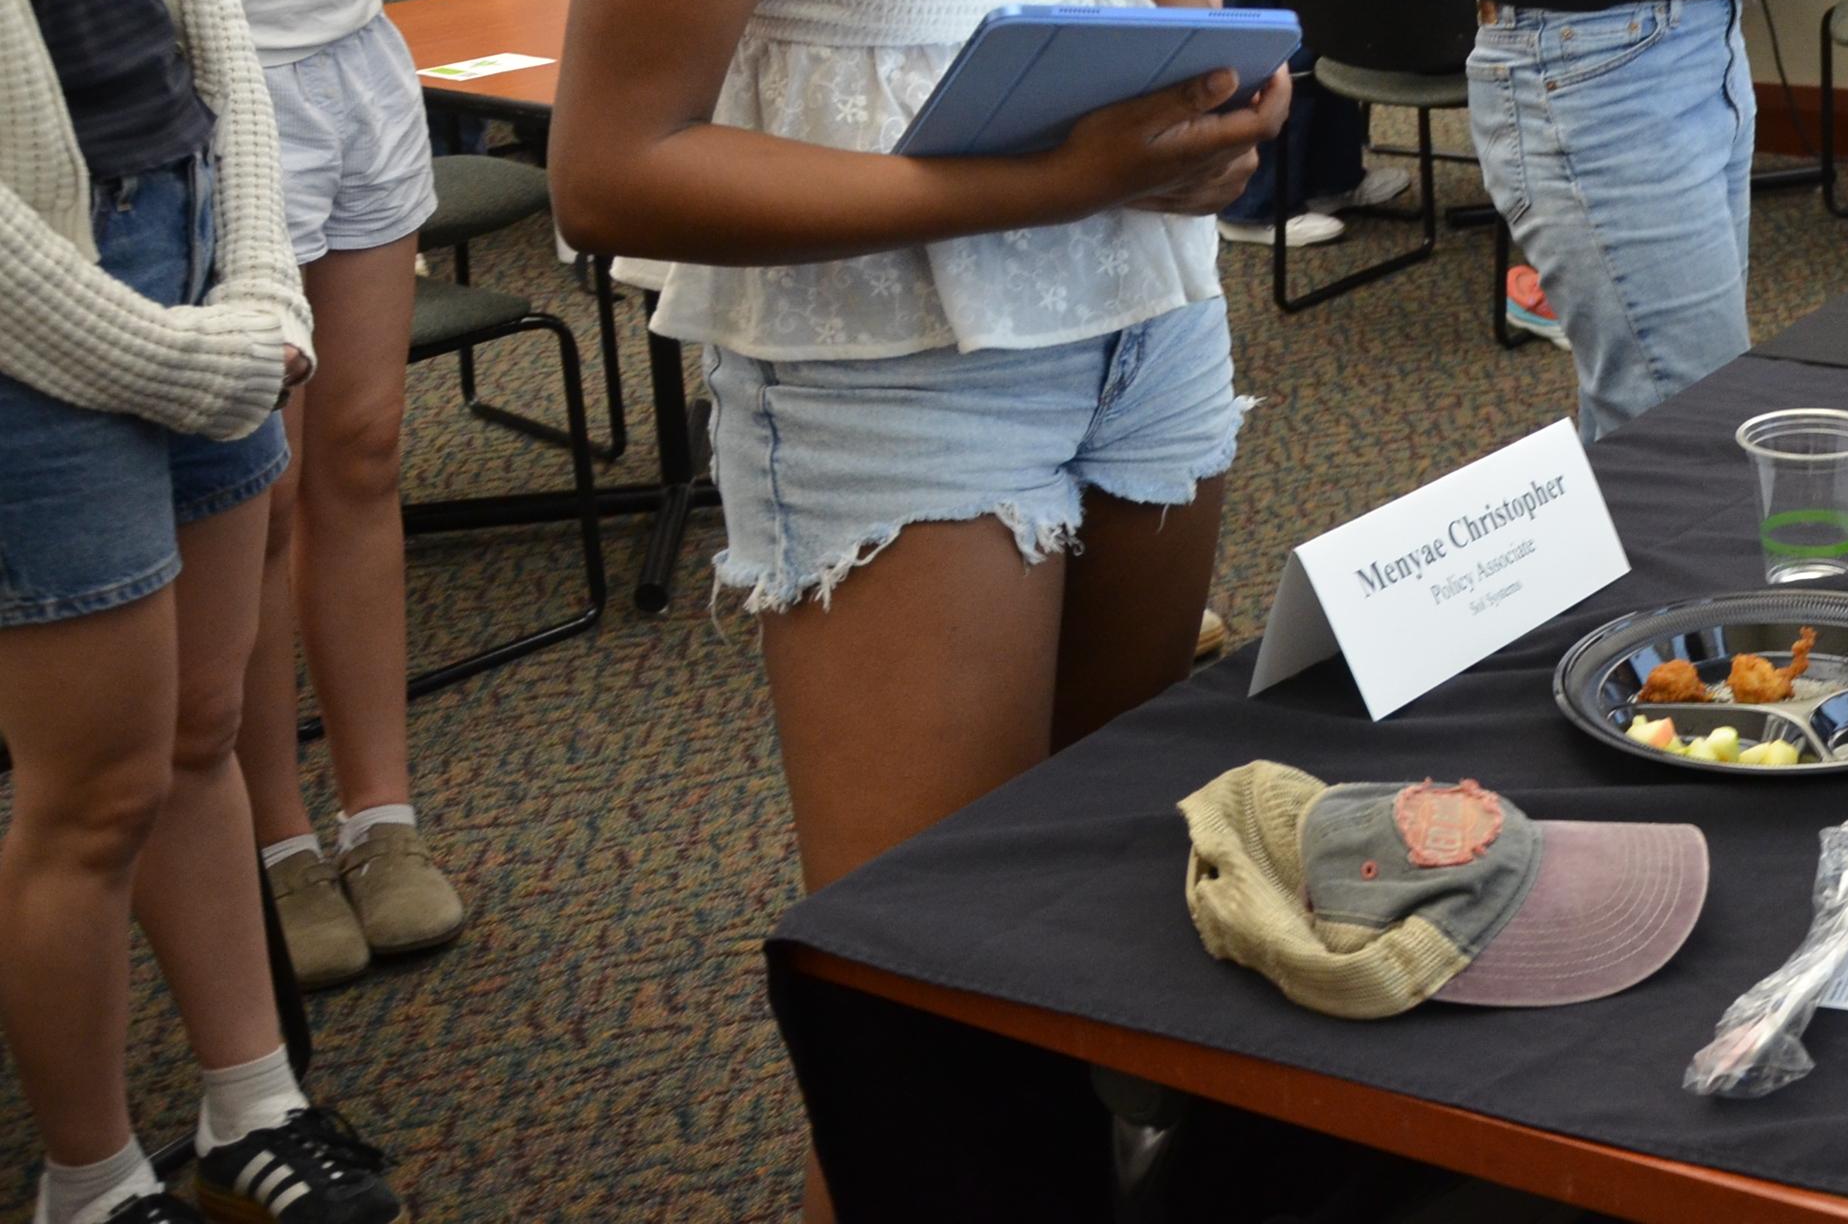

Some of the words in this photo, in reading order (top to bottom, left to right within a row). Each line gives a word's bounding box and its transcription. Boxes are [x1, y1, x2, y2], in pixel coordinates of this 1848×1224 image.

[1355, 538, 1447, 598] Menyae
[1448, 474, 1567, 549] Christopher
[1430, 570, 1475, 605] Policy
[1478, 537, 1536, 582] Associate
